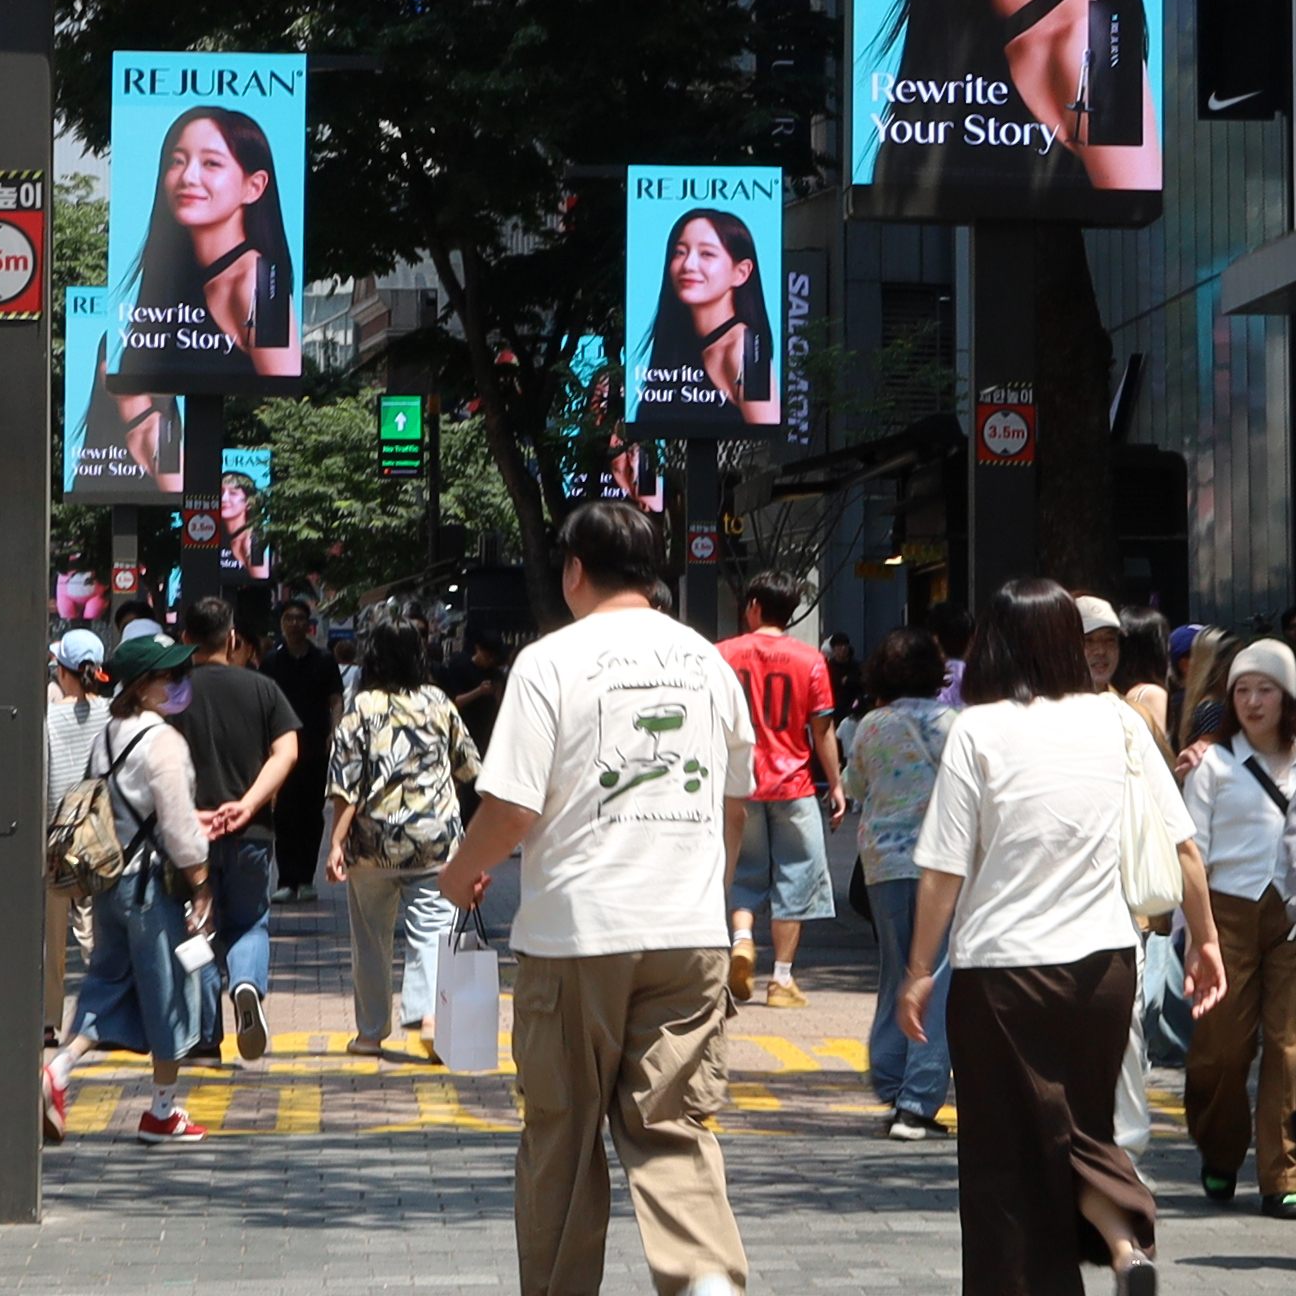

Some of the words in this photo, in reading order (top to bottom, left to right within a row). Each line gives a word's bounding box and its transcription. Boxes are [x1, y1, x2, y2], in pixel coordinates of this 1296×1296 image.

[123, 68, 295, 97] REJURAN
[871, 71, 1008, 106] Rewrite
[871, 114, 954, 146] Your
[964, 114, 1059, 156] Story
[636, 176, 773, 202] REJURAN
[118, 301, 205, 325] Rewrite
[118, 328, 171, 350] Your
[176, 328, 238, 356] Story
[634, 364, 704, 383] Rewrite
[634, 386, 675, 404] Your
[680, 386, 730, 408] Story
[988, 425, 1025, 440] 3.5m
[110, 462, 148, 481] Story
[738, 668, 793, 731] 10
